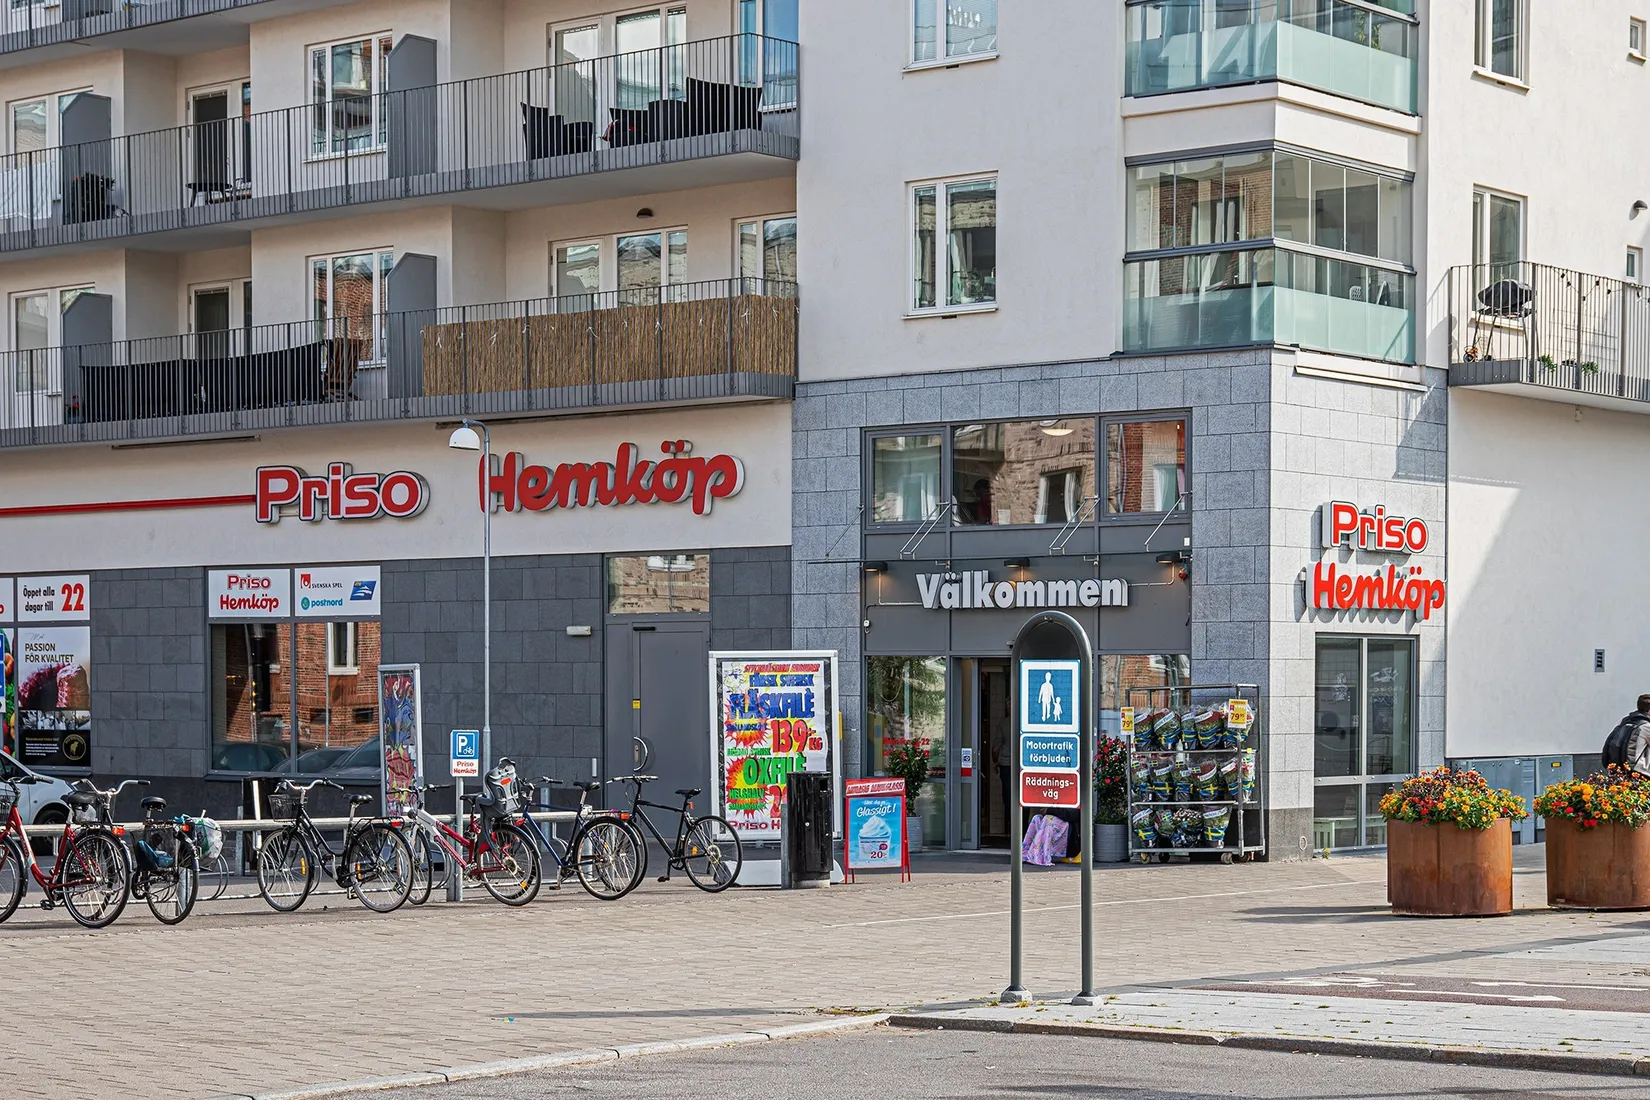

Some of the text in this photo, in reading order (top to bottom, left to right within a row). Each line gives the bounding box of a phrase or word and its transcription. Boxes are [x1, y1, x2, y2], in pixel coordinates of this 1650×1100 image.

[479, 440, 744, 515] Hemköp
[255, 461, 429, 524] Priso
[1328, 500, 1429, 554] Priso
[227, 573, 271, 590] Priso
[23, 585, 55, 598] Öppet alla
[915, 570, 1129, 609] Välkommen
[1311, 561, 1445, 620] Hemköp
[61, 583, 84, 611] 22
[220, 594, 279, 612] Hemköp
[311, 598, 343, 608] postnord
[25, 601, 54, 613] dagar till
[25, 643, 56, 652] PASSION
[25, 653, 74, 663] FÖR KVALITET
[459, 735, 468, 753] P
[1026, 741, 1074, 750] Motortrafik
[1030, 753, 1071, 764] förbjuden
[1025, 777, 1075, 788] Räddnings-
[1042, 789, 1059, 800] väg
[728, 820, 768, 830] Priso
